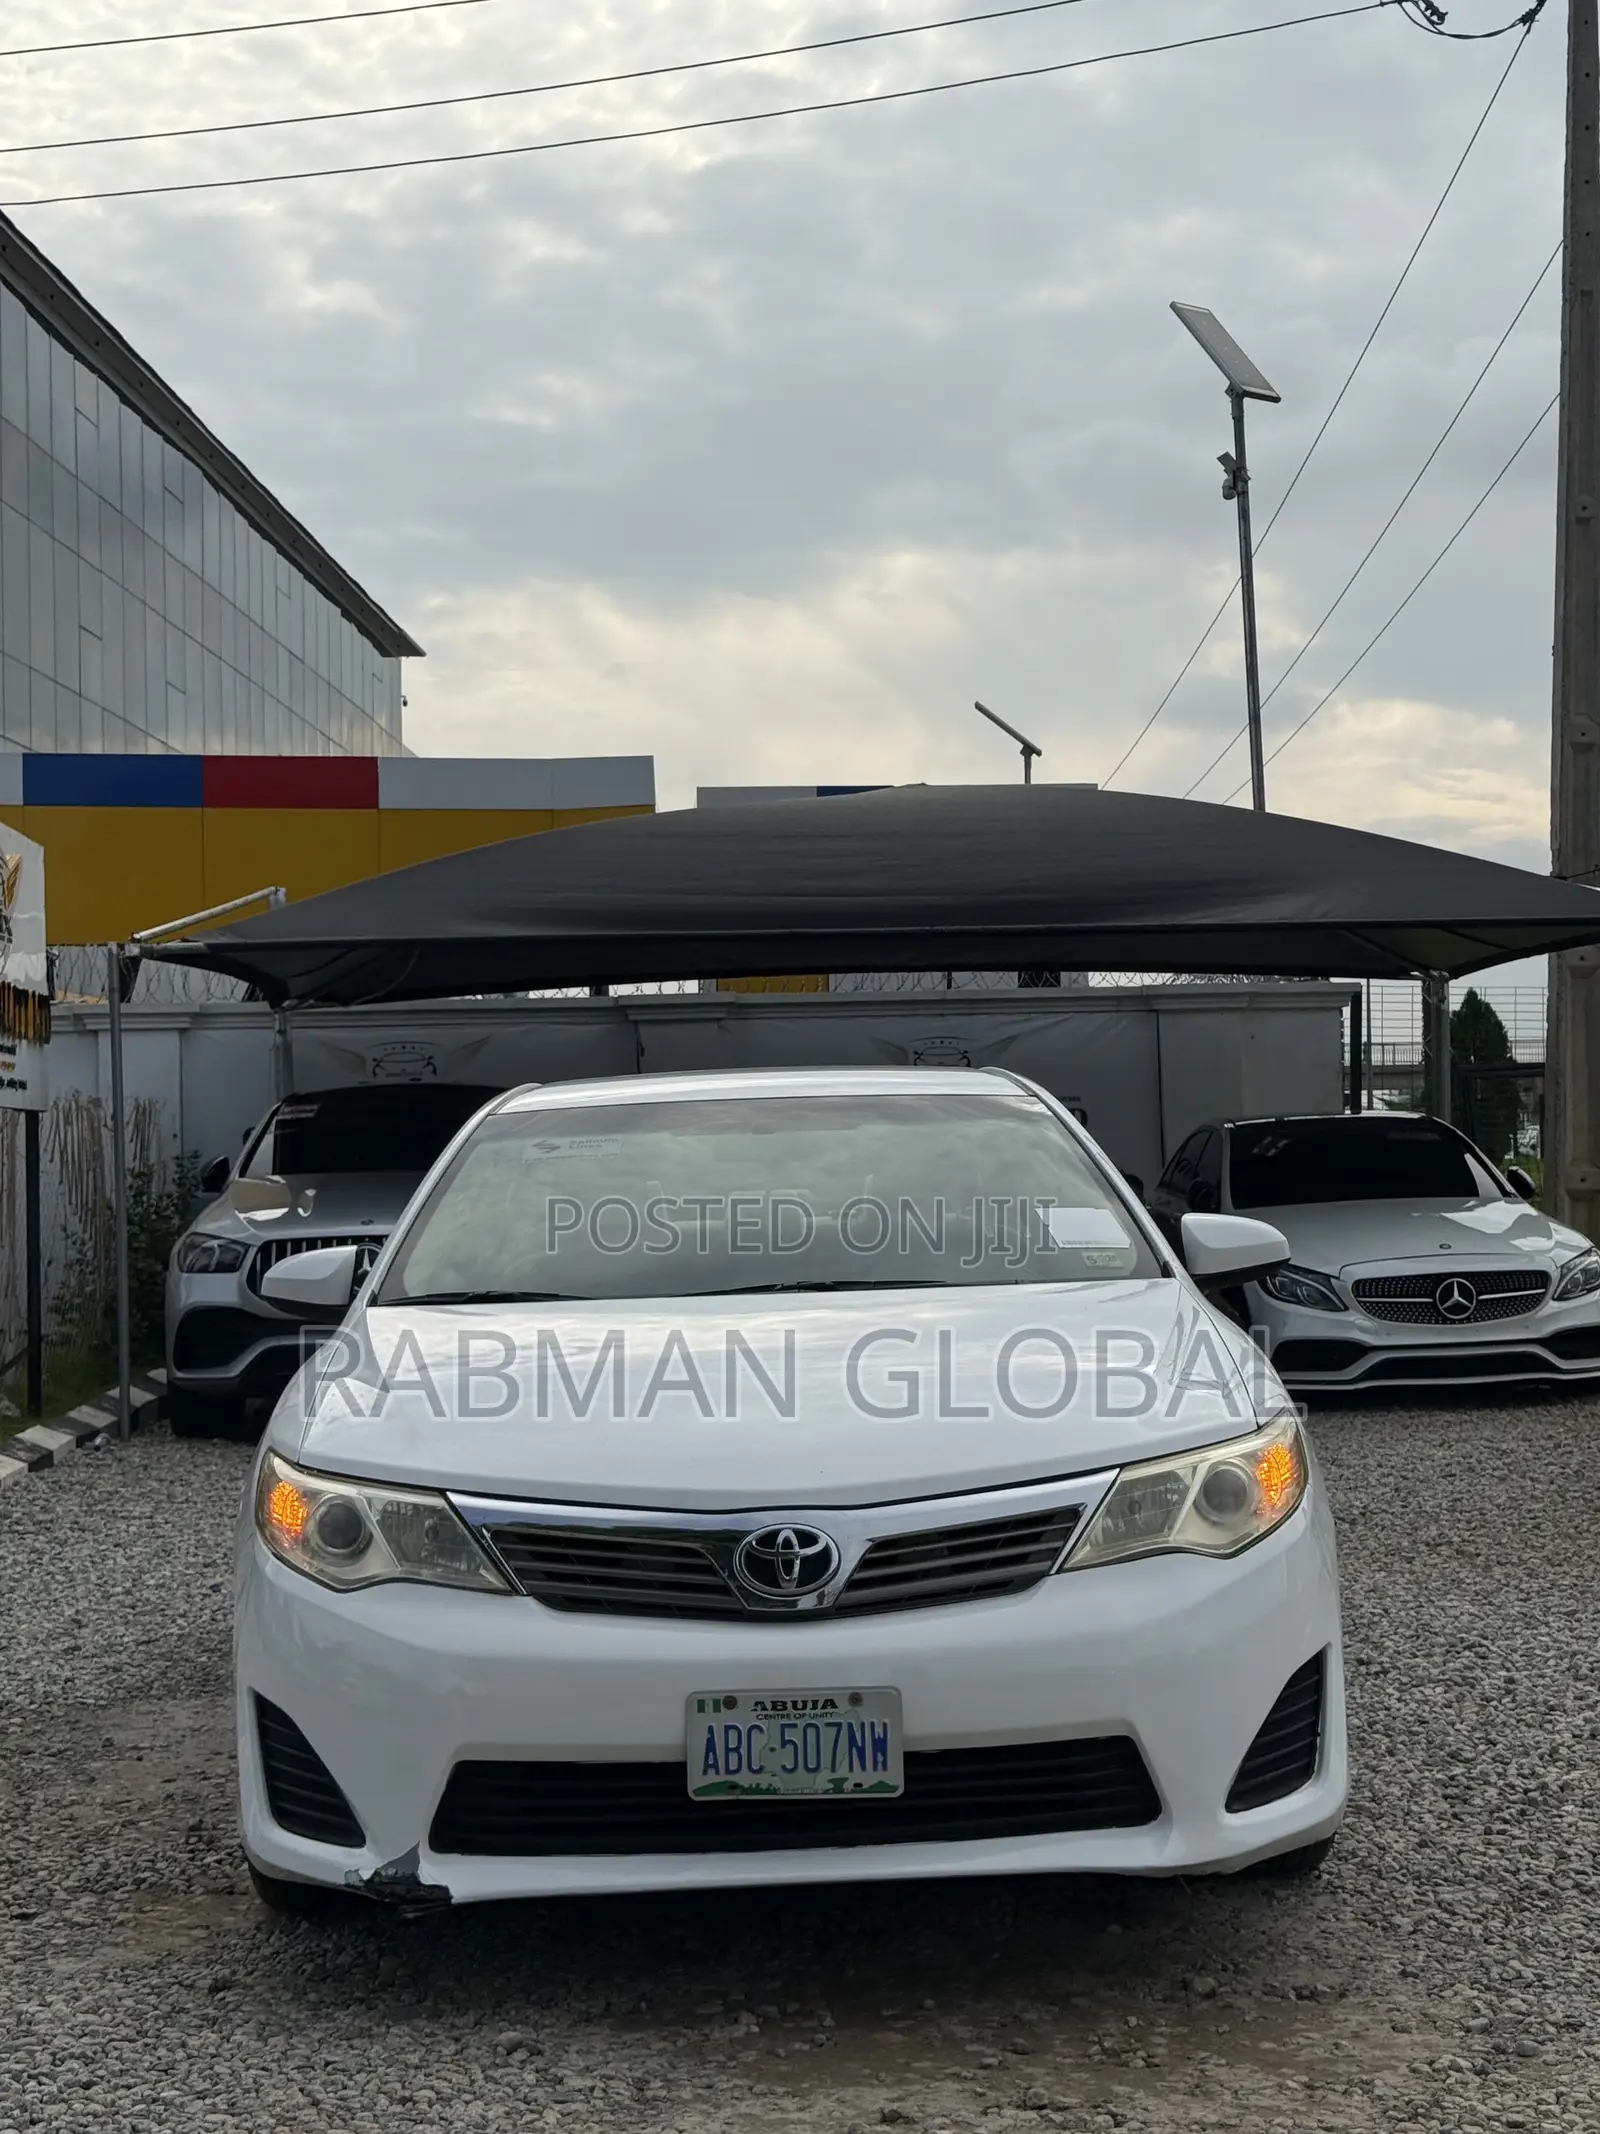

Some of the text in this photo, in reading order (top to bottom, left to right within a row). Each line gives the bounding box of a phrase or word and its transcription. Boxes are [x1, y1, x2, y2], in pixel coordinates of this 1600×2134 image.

[751, 1699, 839, 1712] ABUJA
[756, 1711, 835, 1721] CENTRE OF UNITY
